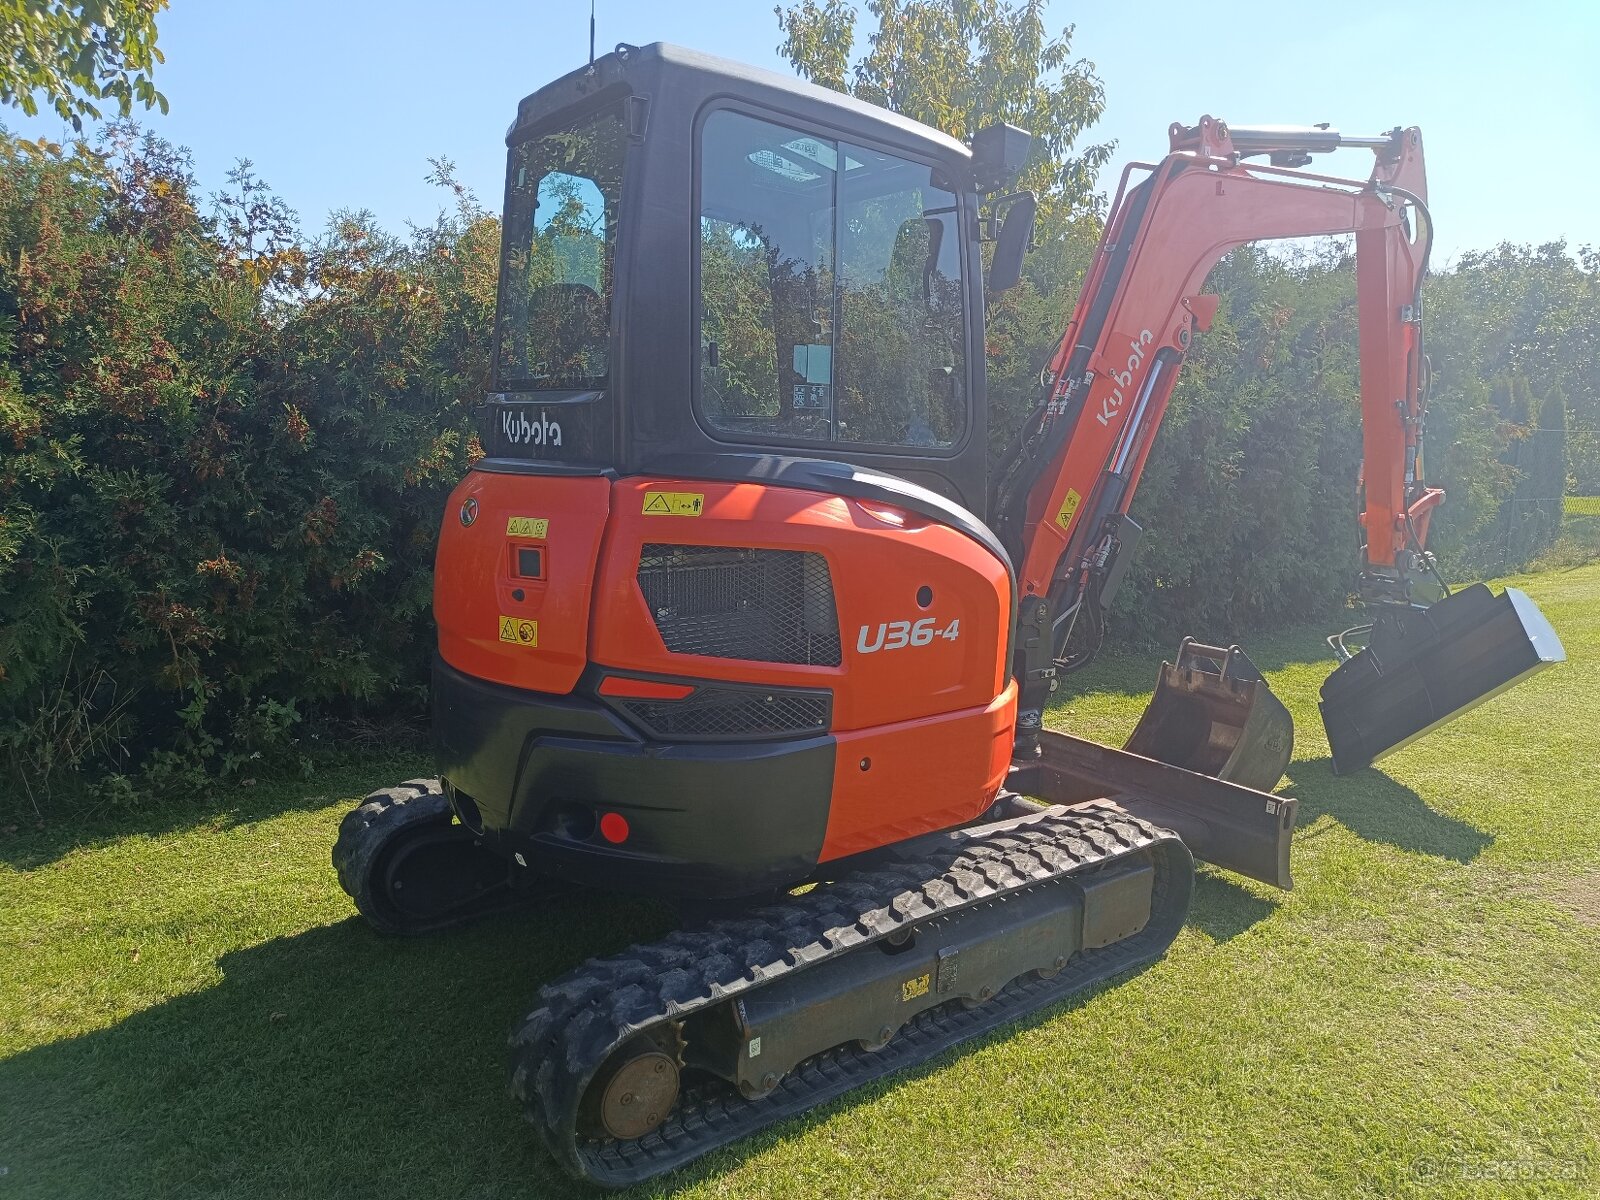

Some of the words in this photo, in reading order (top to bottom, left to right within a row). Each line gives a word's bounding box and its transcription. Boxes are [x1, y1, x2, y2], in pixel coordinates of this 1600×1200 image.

[1096, 329, 1154, 426] Kubota
[503, 410, 562, 446] Kubota
[856, 617, 960, 654] U36-4
